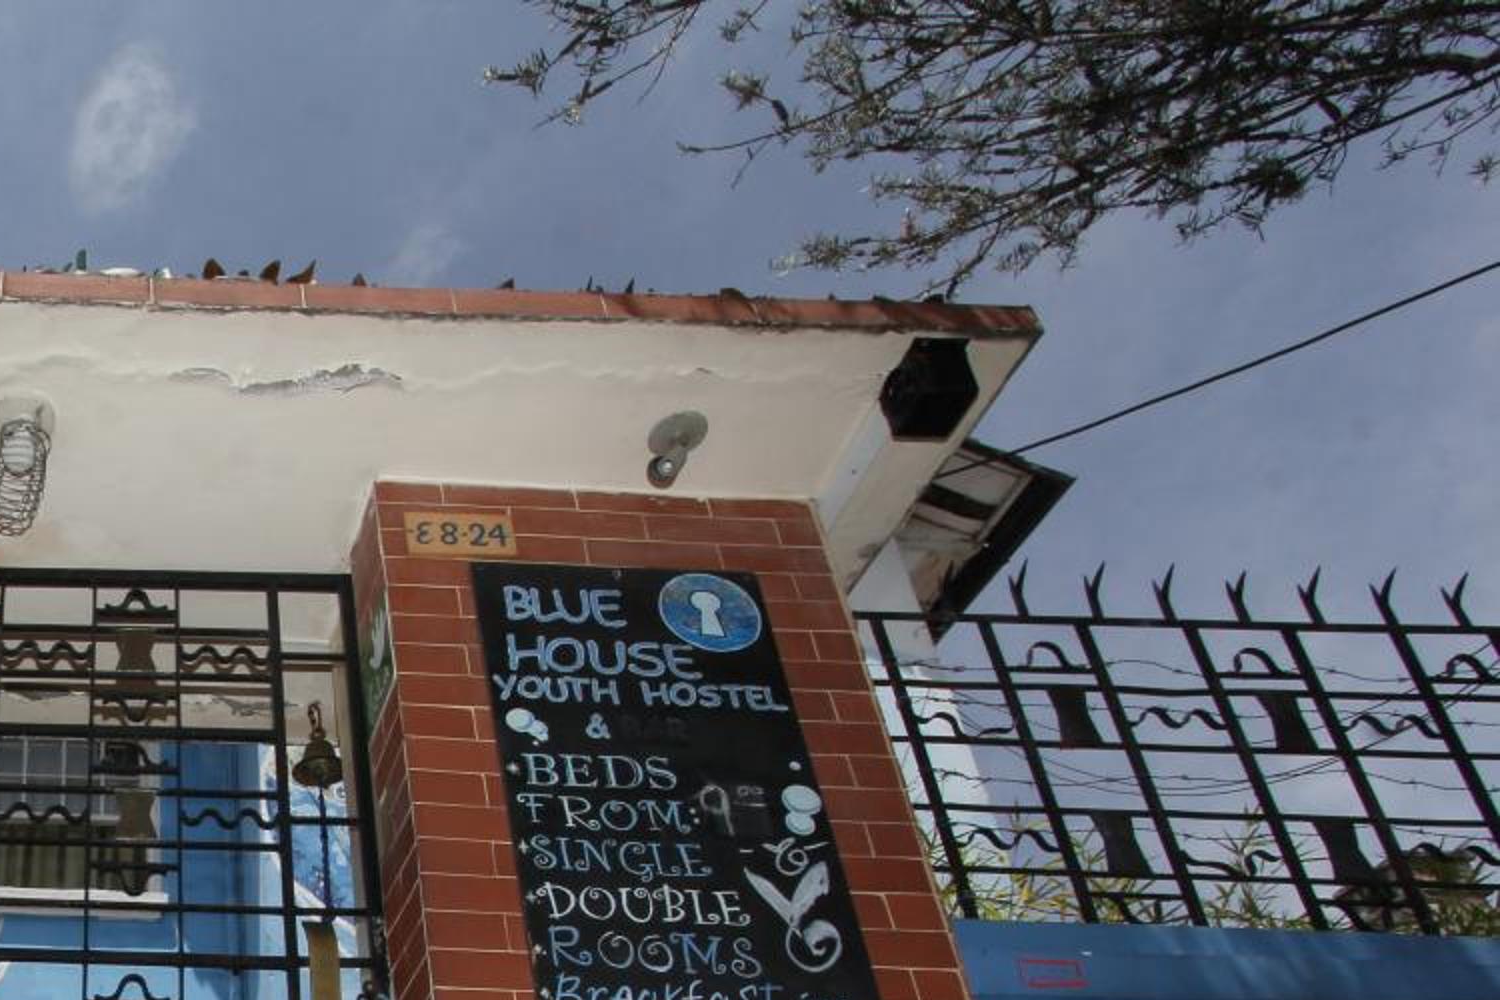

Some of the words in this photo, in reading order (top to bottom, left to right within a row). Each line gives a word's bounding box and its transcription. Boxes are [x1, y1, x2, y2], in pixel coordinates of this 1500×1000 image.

[503, 585, 628, 628] BLUE
[507, 633, 705, 681] HOUSE
[493, 674, 620, 707] YOUTH
[640, 682, 790, 712] HOSTEL
[585, 712, 612, 740] &
[520, 753, 680, 791] BEDS
[530, 834, 714, 883] SINGLE
[536, 881, 752, 927] DOUBLE
[548, 925, 764, 979] ROOMS
